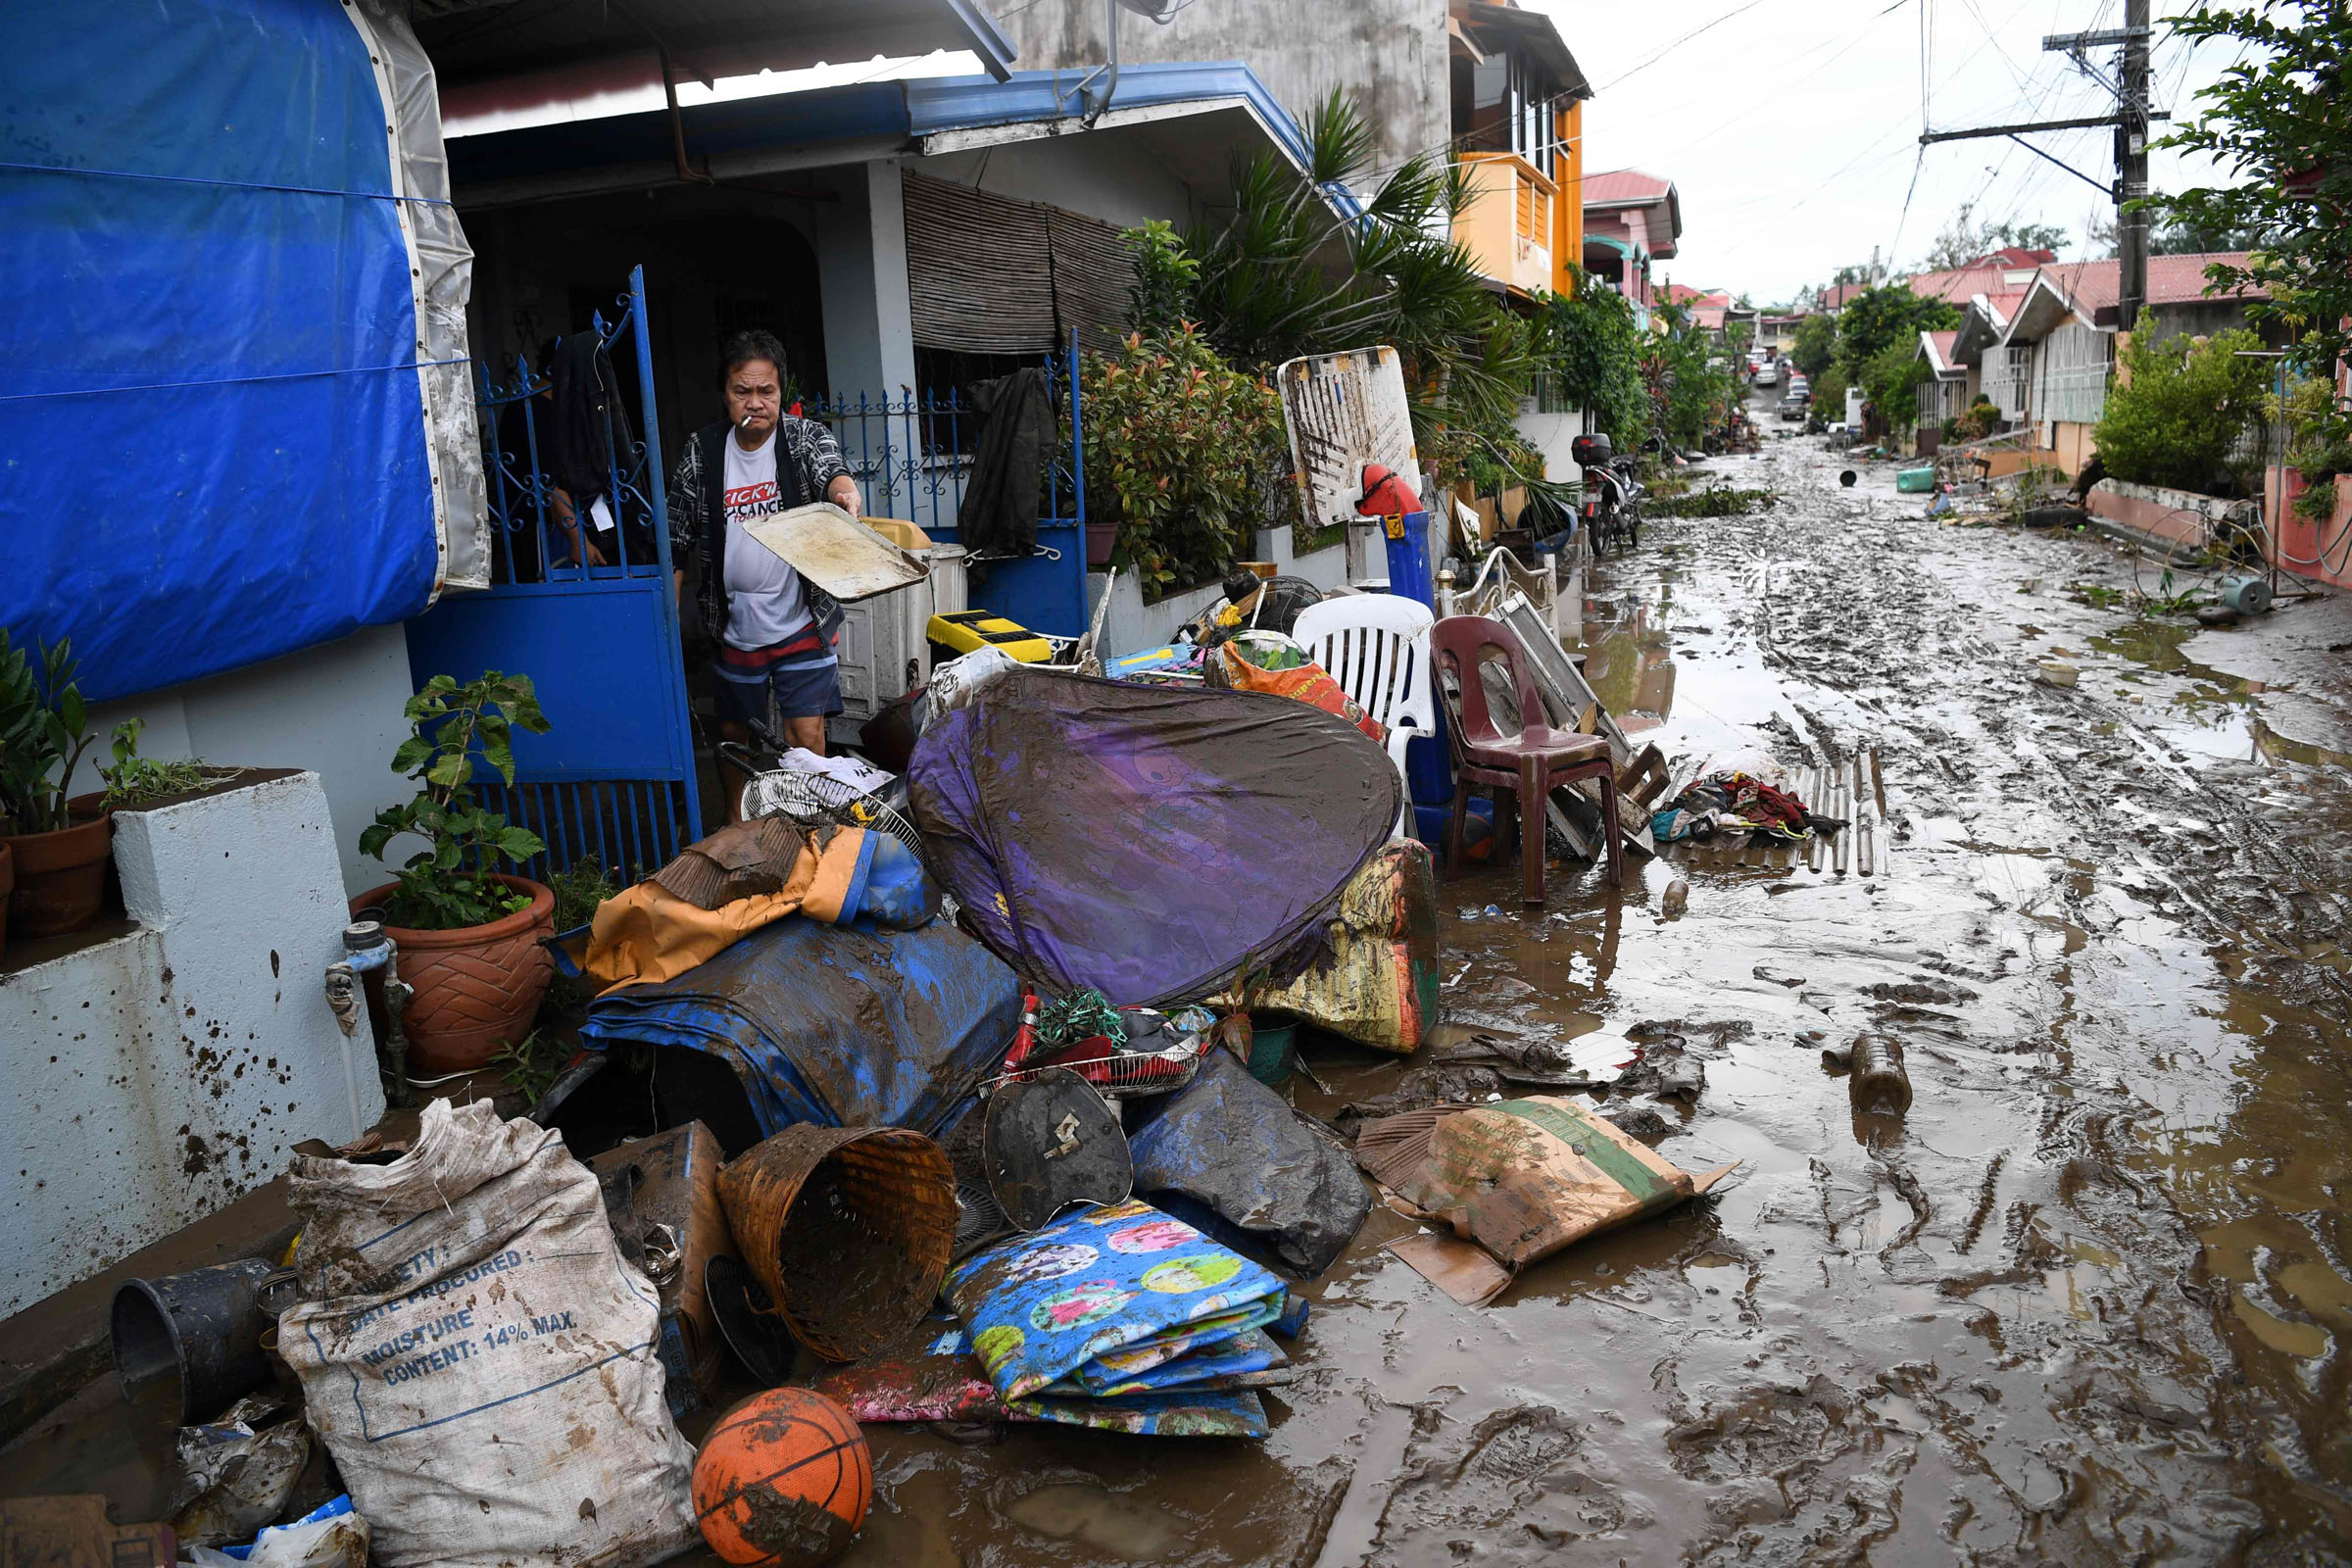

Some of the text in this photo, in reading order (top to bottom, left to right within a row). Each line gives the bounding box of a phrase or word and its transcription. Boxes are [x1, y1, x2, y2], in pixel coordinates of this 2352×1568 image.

[346, 1300, 403, 1333] DATE
[362, 1308, 475, 1368] MOISTURE
[382, 1310, 578, 1387] CONTENT: 14% MAX.
